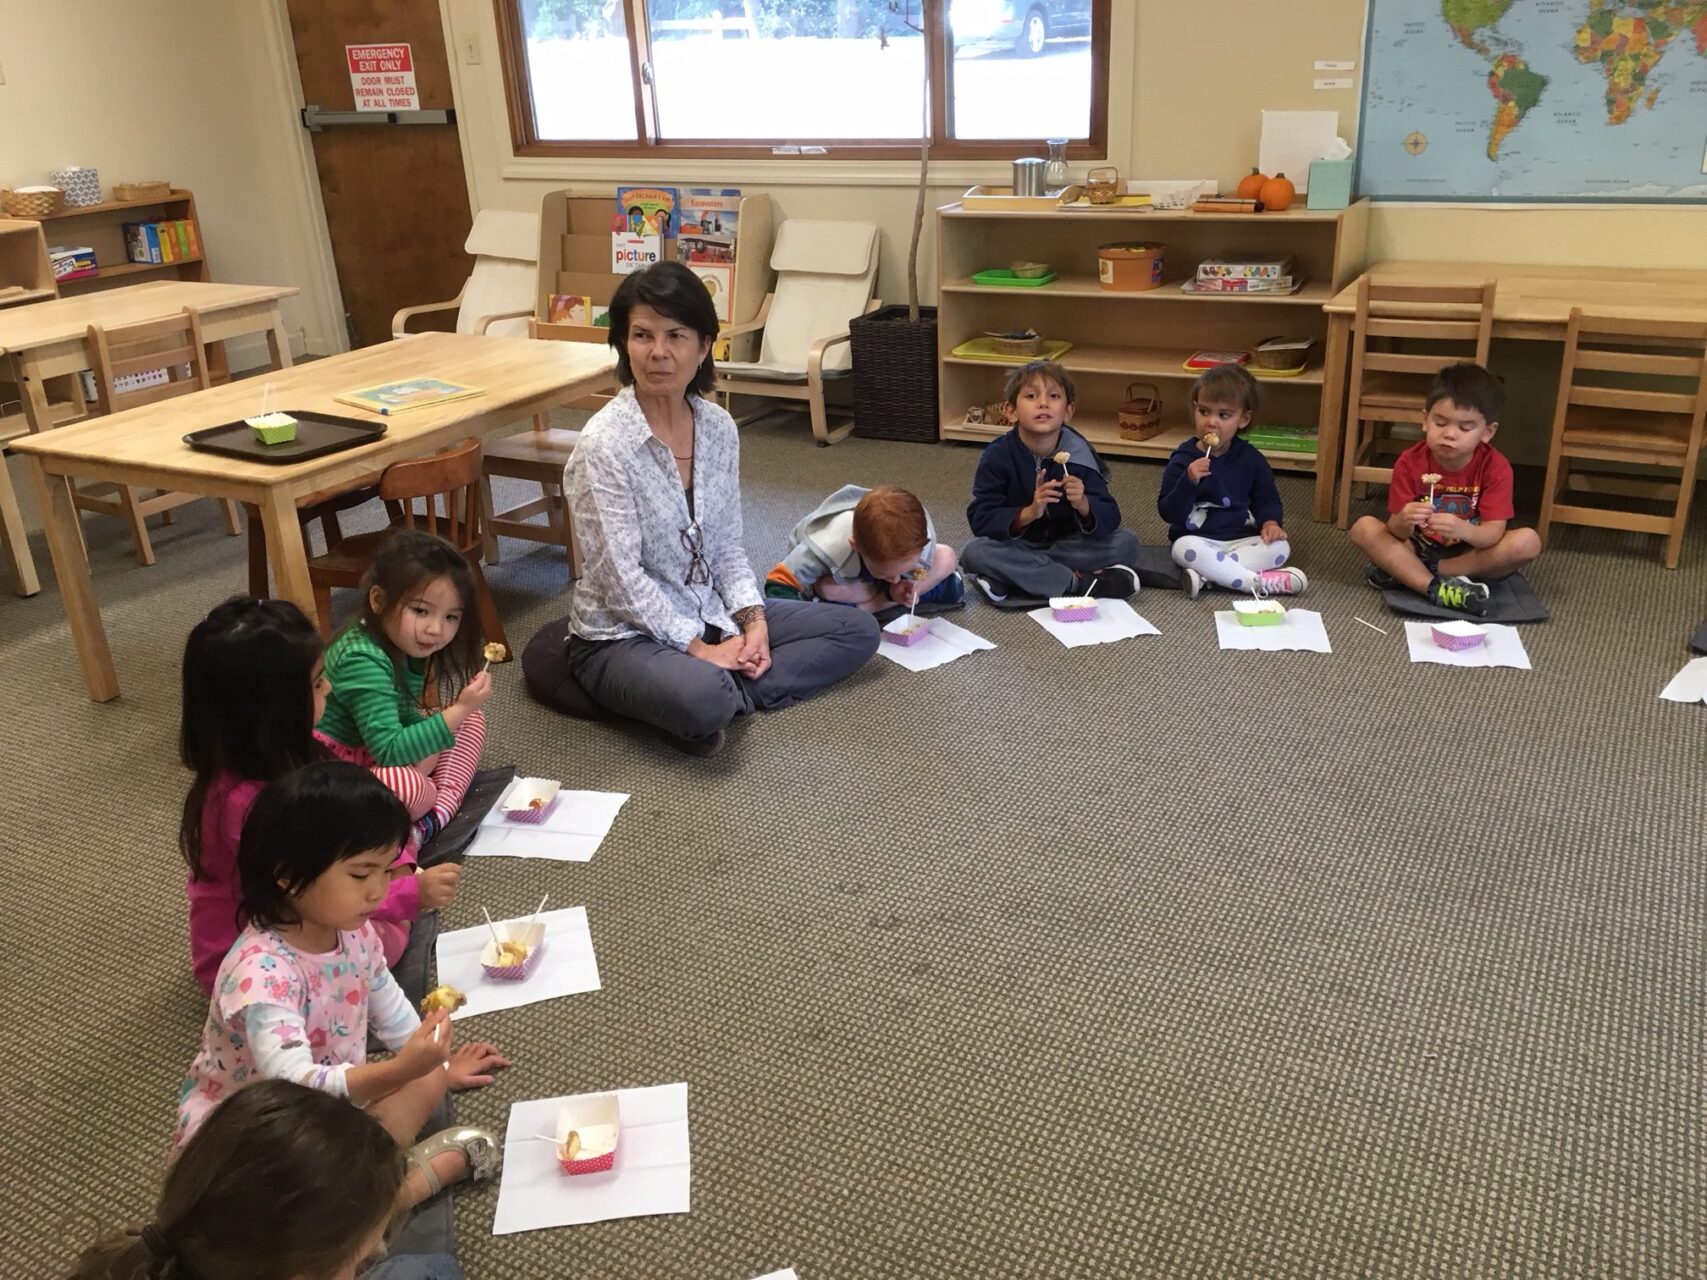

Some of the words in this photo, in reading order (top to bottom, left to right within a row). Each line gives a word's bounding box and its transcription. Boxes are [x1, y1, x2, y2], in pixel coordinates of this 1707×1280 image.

[352, 48, 405, 60] EMERGENCY
[360, 61, 378, 71] EXIT
[380, 60, 402, 70] ONLY
[361, 77, 382, 85] DOOR
[384, 76, 405, 85] MUST
[355, 88, 384, 97] REMAIN
[386, 87, 415, 96] CLOSED
[362, 100, 371, 108] AT
[373, 99, 387, 108] ALL
[388, 98, 412, 107] TIMES
[616, 249, 656, 263] picture
